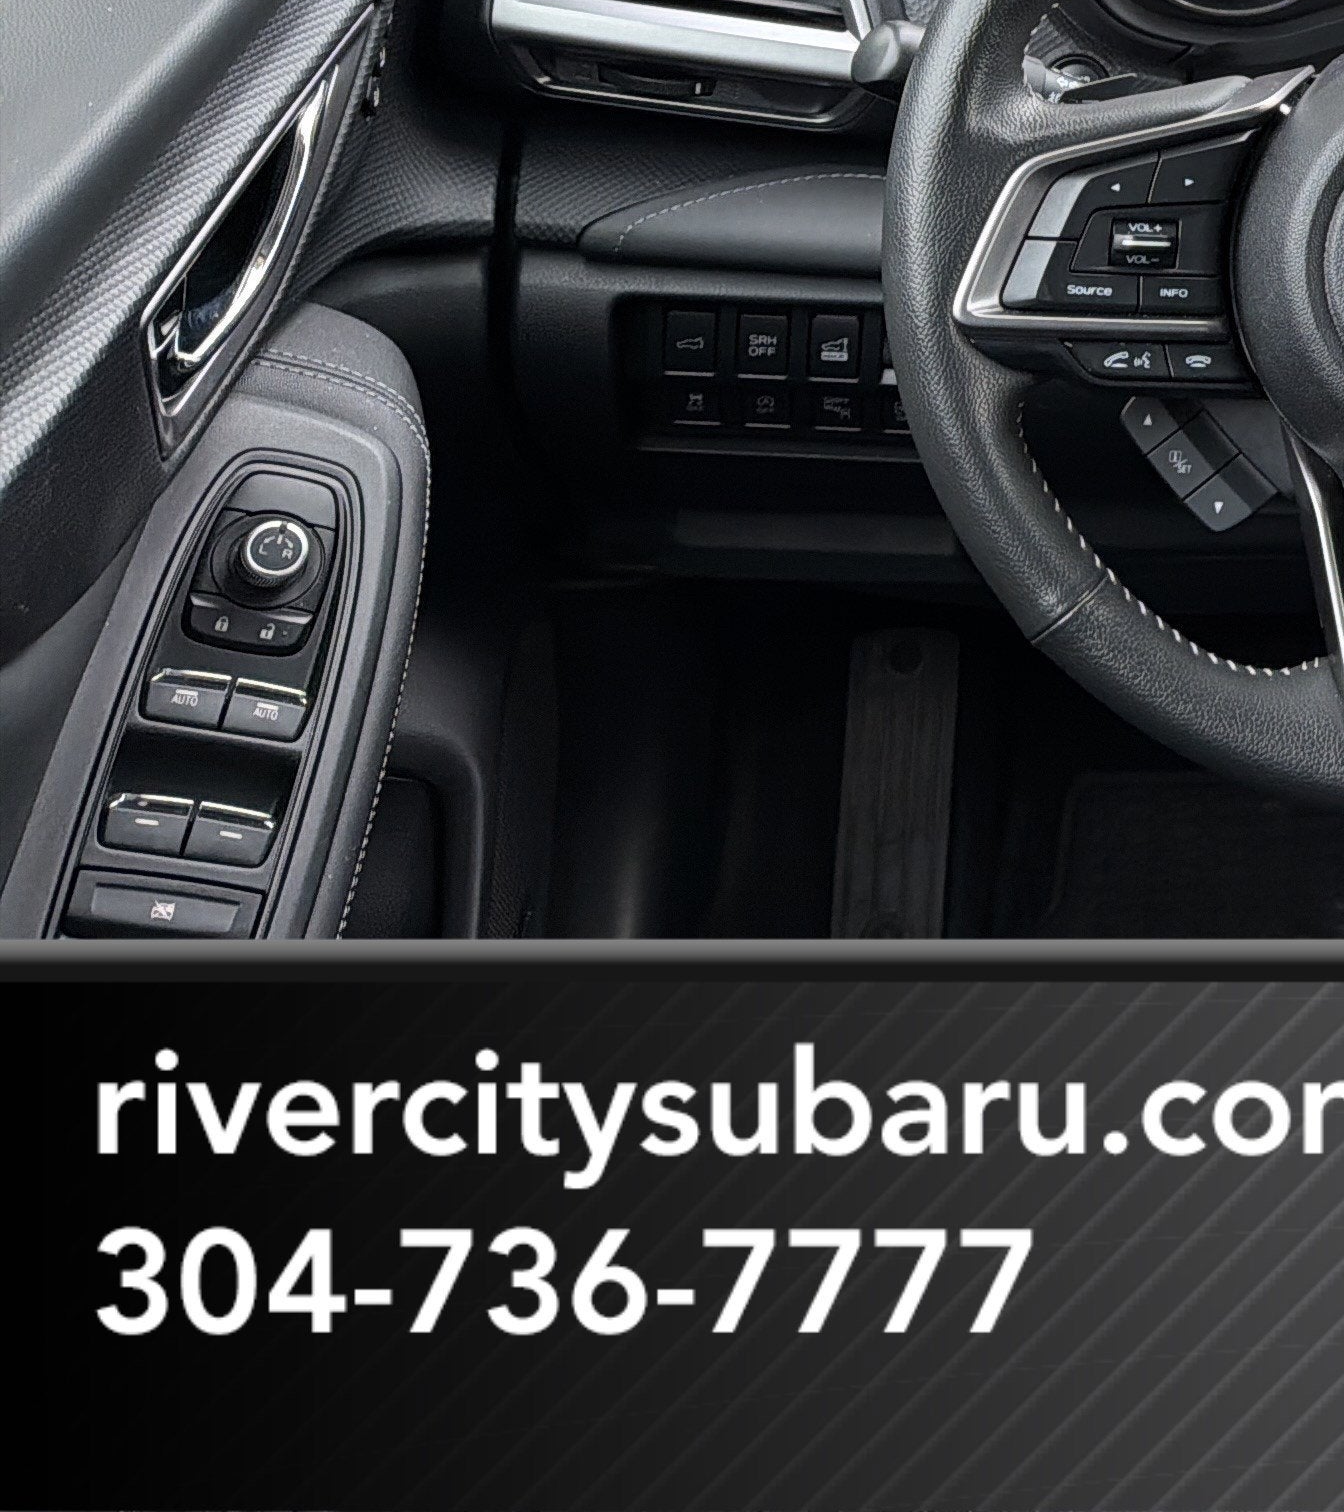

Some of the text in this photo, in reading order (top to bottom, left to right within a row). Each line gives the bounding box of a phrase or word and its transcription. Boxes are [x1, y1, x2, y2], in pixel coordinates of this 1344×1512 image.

[1067, 284, 1113, 298] Source
[1159, 288, 1189, 299] INFO
[748, 334, 778, 346] SRH
[748, 346, 777, 357] OFF
[170, 693, 200, 708] AUTO
[252, 707, 280, 721] AUTO
